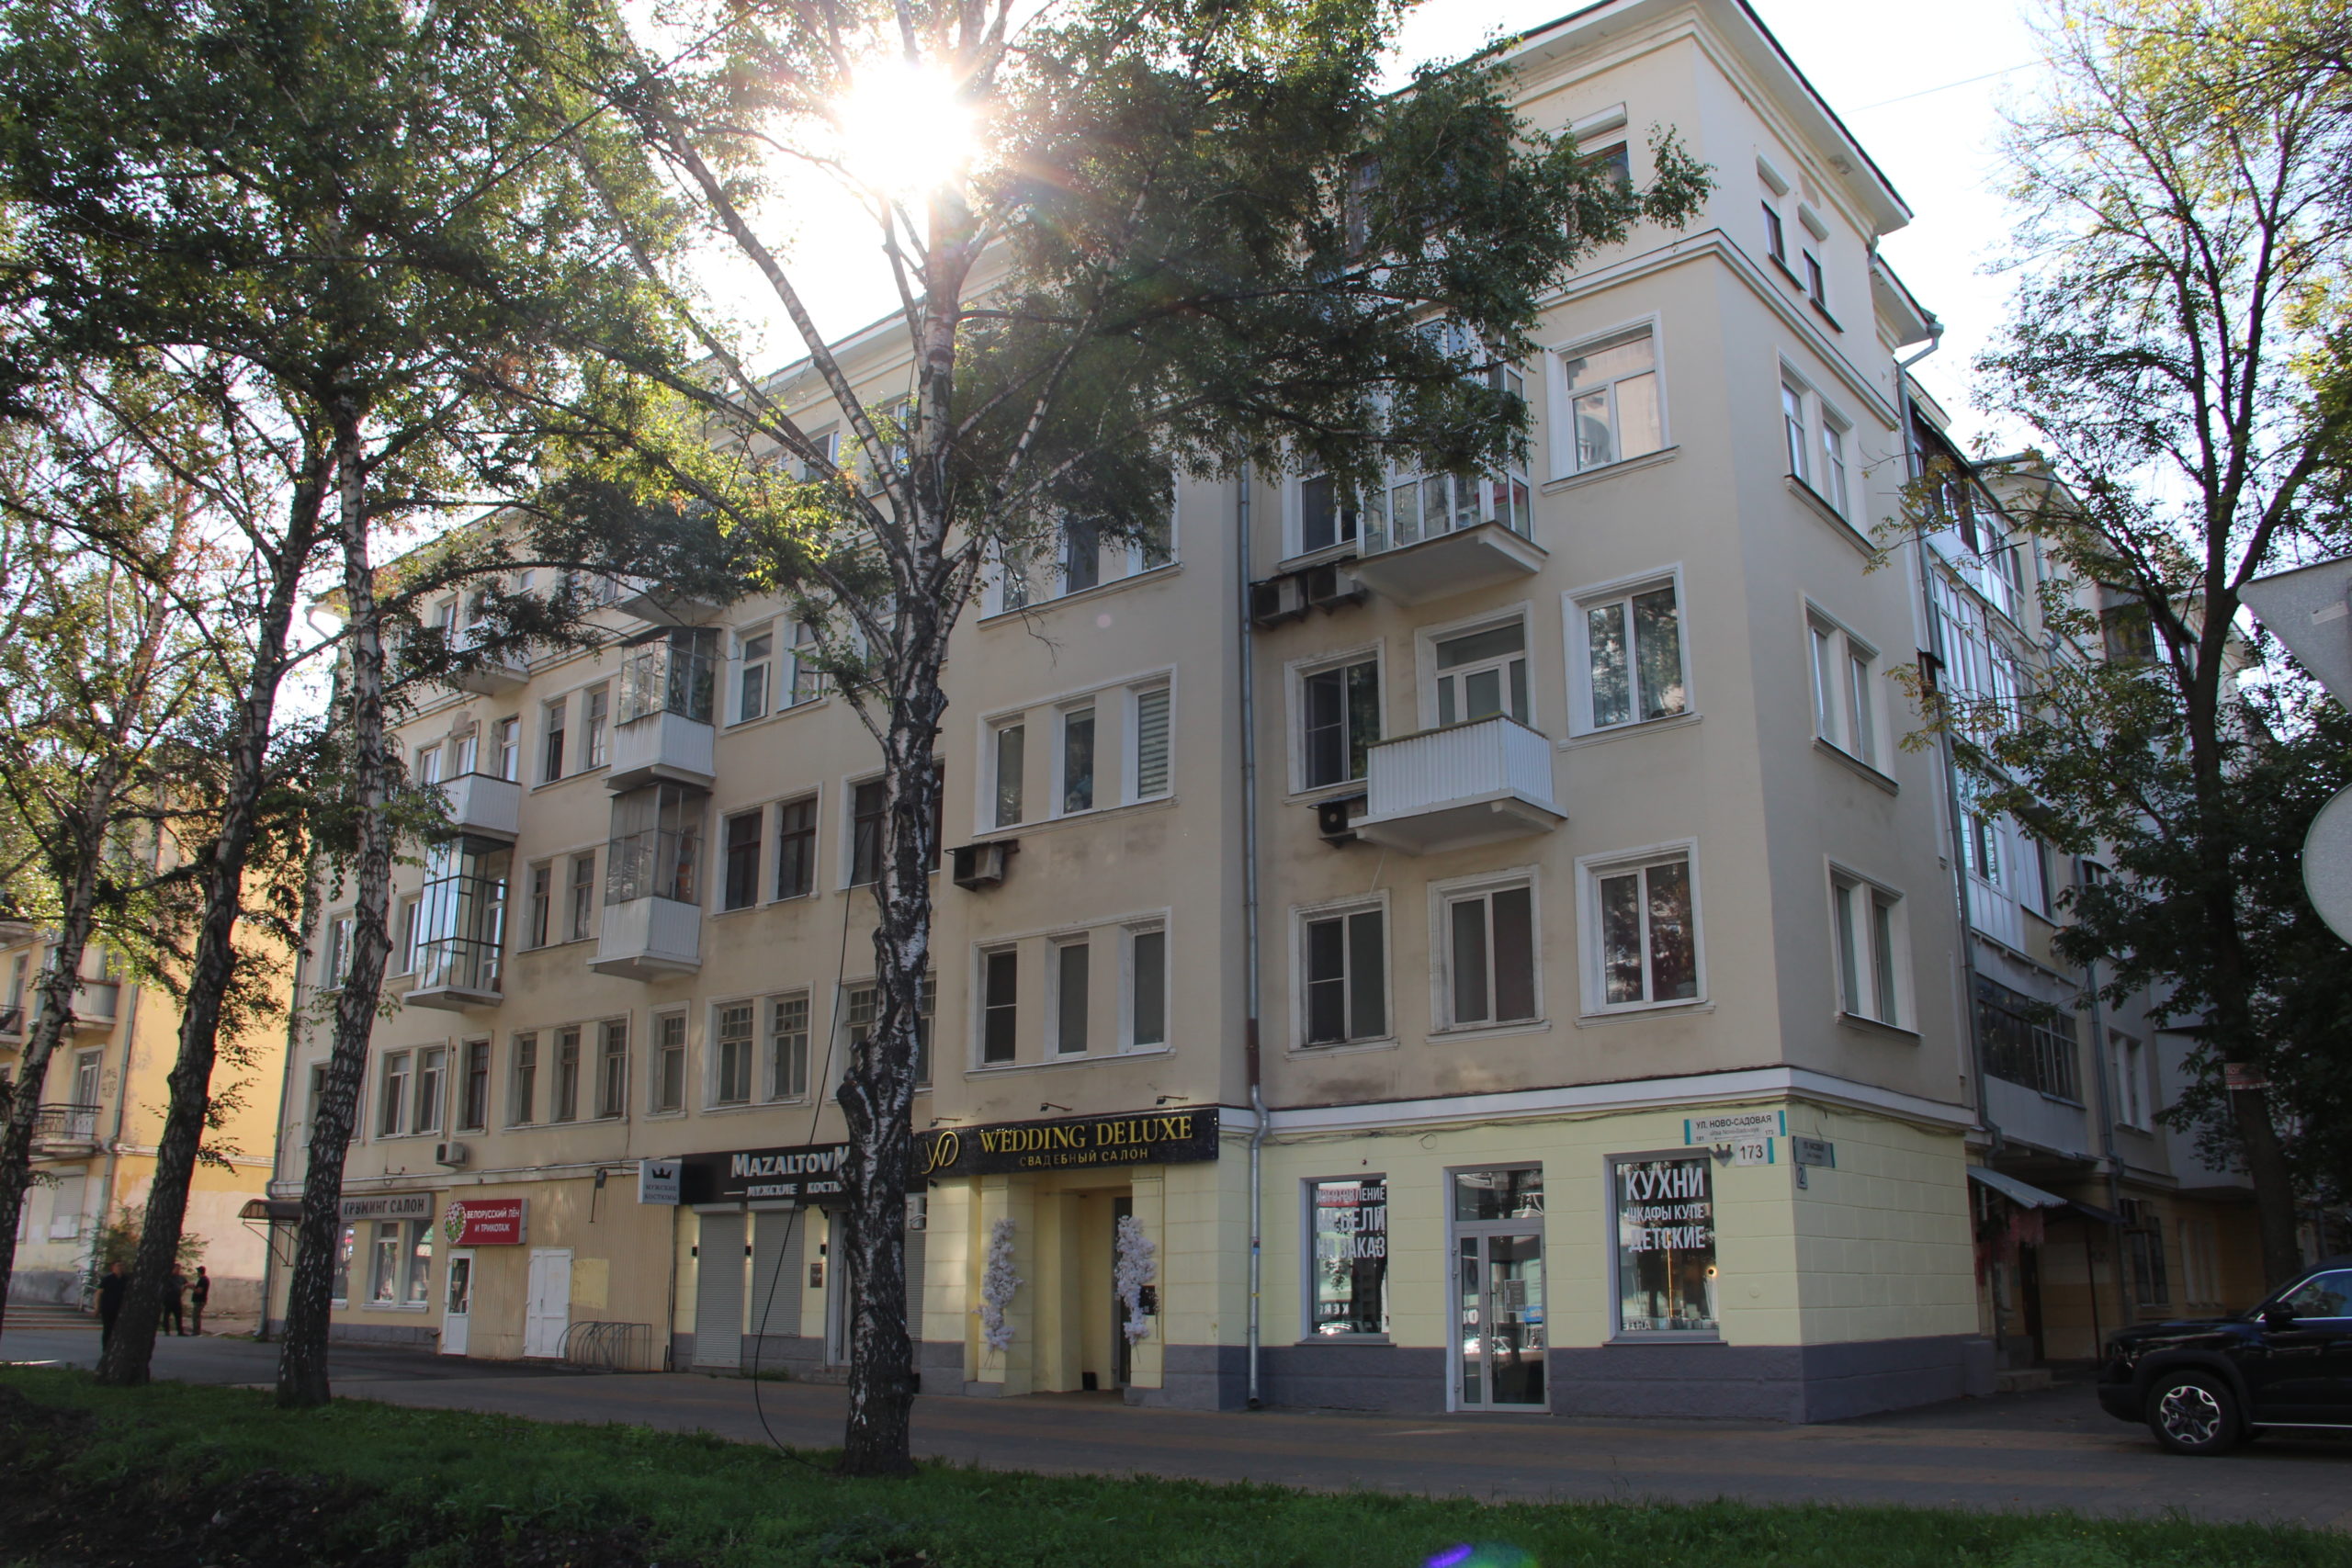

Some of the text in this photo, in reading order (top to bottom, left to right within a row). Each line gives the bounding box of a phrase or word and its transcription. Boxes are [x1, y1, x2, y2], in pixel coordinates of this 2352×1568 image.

[1696, 1115, 1771, 1130] УЛ. НОВО-САДОВАЯ
[979, 1124, 1086, 1154] WEDDING
[1096, 1116, 1193, 1145] DELUXE
[1020, 1147, 1148, 1168] СВАДЕБНЫЙ САЛОН
[1740, 1145, 1763, 1160] 173
[746, 1183, 797, 1197] МУЖСКИЕ
[1625, 1168, 1704, 1201] КУХНИ
[645, 1192, 677, 1201] КОСТЮМЫ
[1316, 1187, 1385, 1202] ИЗГОТОВЛЕНИЕ
[344, 1199, 424, 1214] ГРУМИНГ САЛОН
[467, 1207, 521, 1220] БЕЛОРУССКИЙ ЛЁН
[1627, 1204, 1705, 1222] ШКАФЫ КУПЕ
[1317, 1206, 1385, 1232] МЕБЕЛИ
[481, 1224, 511, 1233] ТРИКОТАЖ
[1317, 1236, 1385, 1258] НА ЗАКАЗ
[1628, 1226, 1706, 1253] ДЕТСКИЕ
